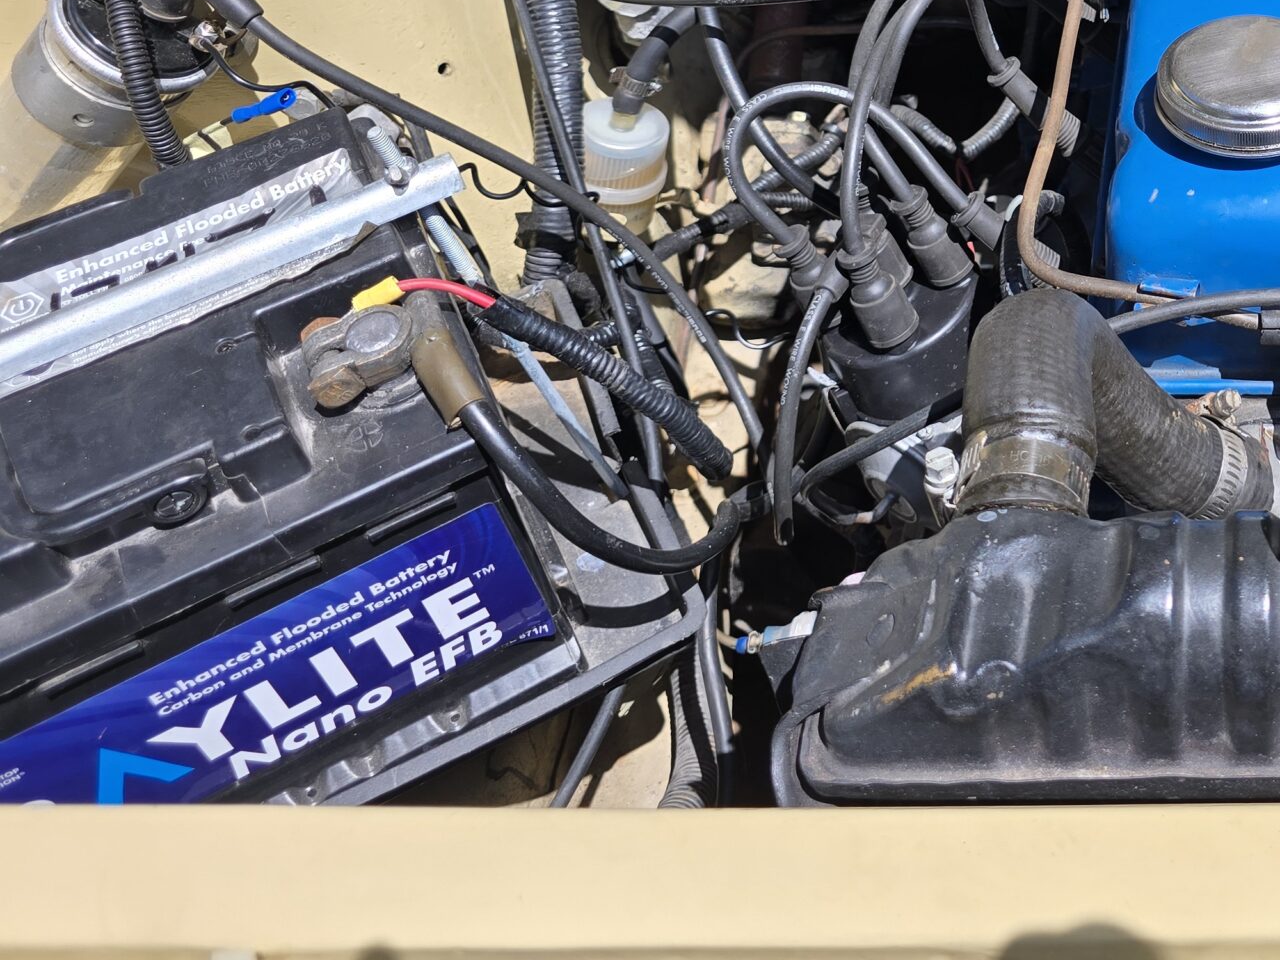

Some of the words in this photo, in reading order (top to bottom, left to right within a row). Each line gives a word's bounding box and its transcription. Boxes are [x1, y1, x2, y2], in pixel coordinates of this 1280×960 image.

[54, 229, 170, 284] Enhanced
[175, 194, 266, 242] Flooded
[270, 154, 351, 204] Battery
[790, 337, 804, 363] WIRE
[147, 642, 269, 708] Enhanced
[269, 591, 366, 650] Flooded
[367, 547, 454, 599] Battery
[156, 678, 228, 718] Carbon
[228, 657, 267, 686] and
[267, 611, 364, 664] Membrane
[362, 560, 459, 616] Technology
[230, 685, 393, 780] Nano
[410, 620, 504, 687] EFB
